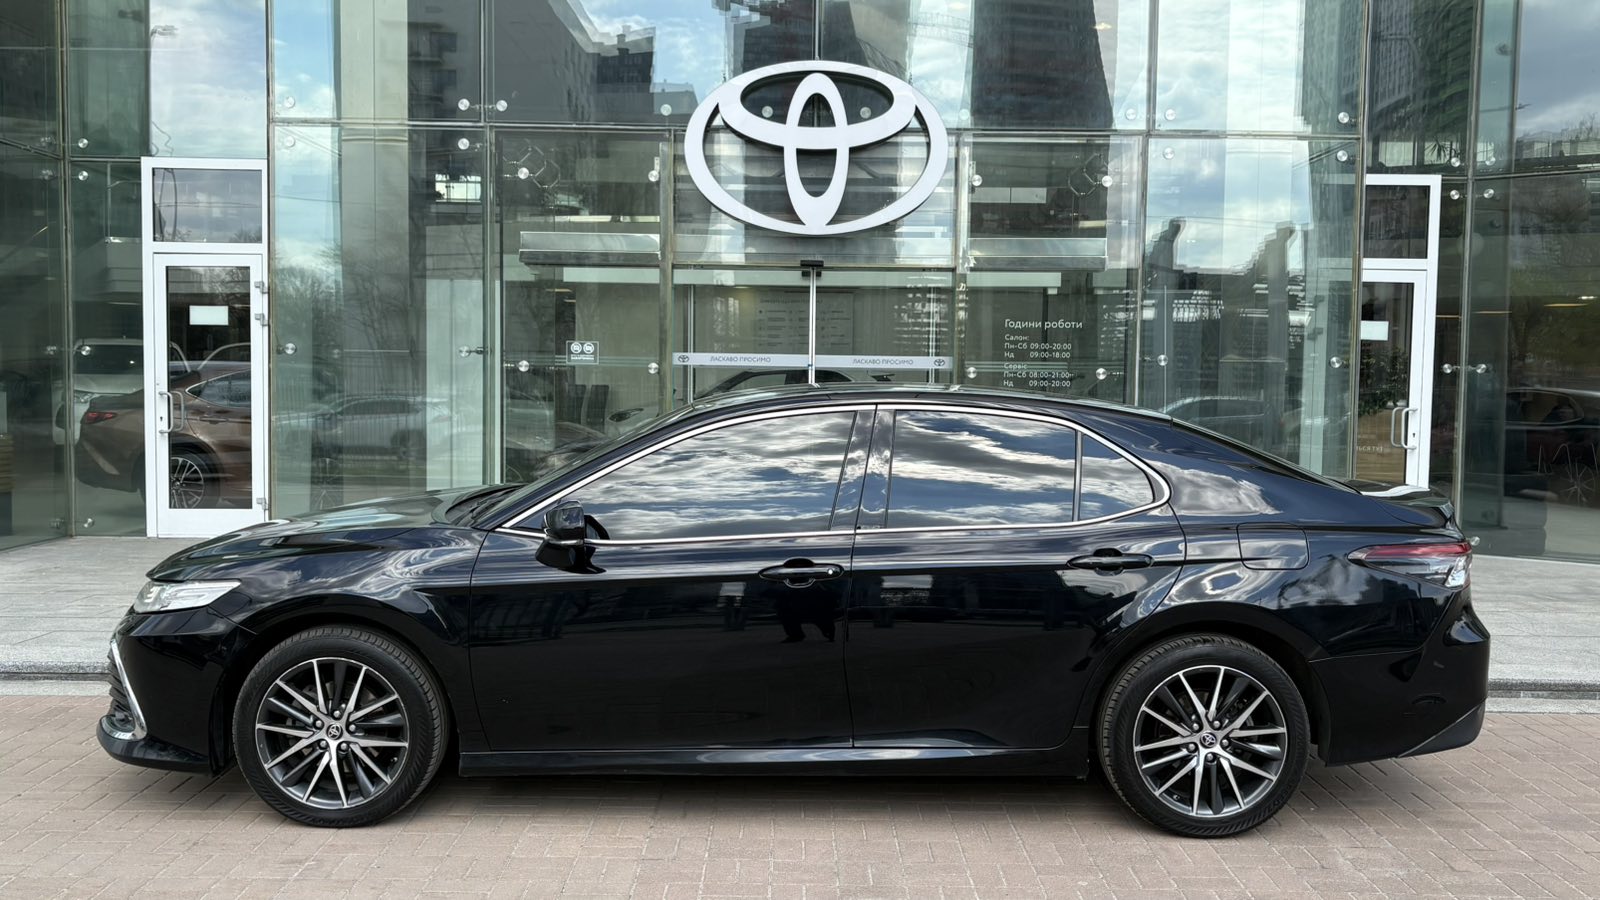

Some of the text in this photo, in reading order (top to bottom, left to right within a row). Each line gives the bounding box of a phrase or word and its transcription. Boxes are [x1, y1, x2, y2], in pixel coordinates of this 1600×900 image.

[1004, 318, 1083, 330] Години роботи
[1004, 342, 1028, 350] Пн-Сб
[1004, 351, 1071, 359] Нд 09:00-18:00
